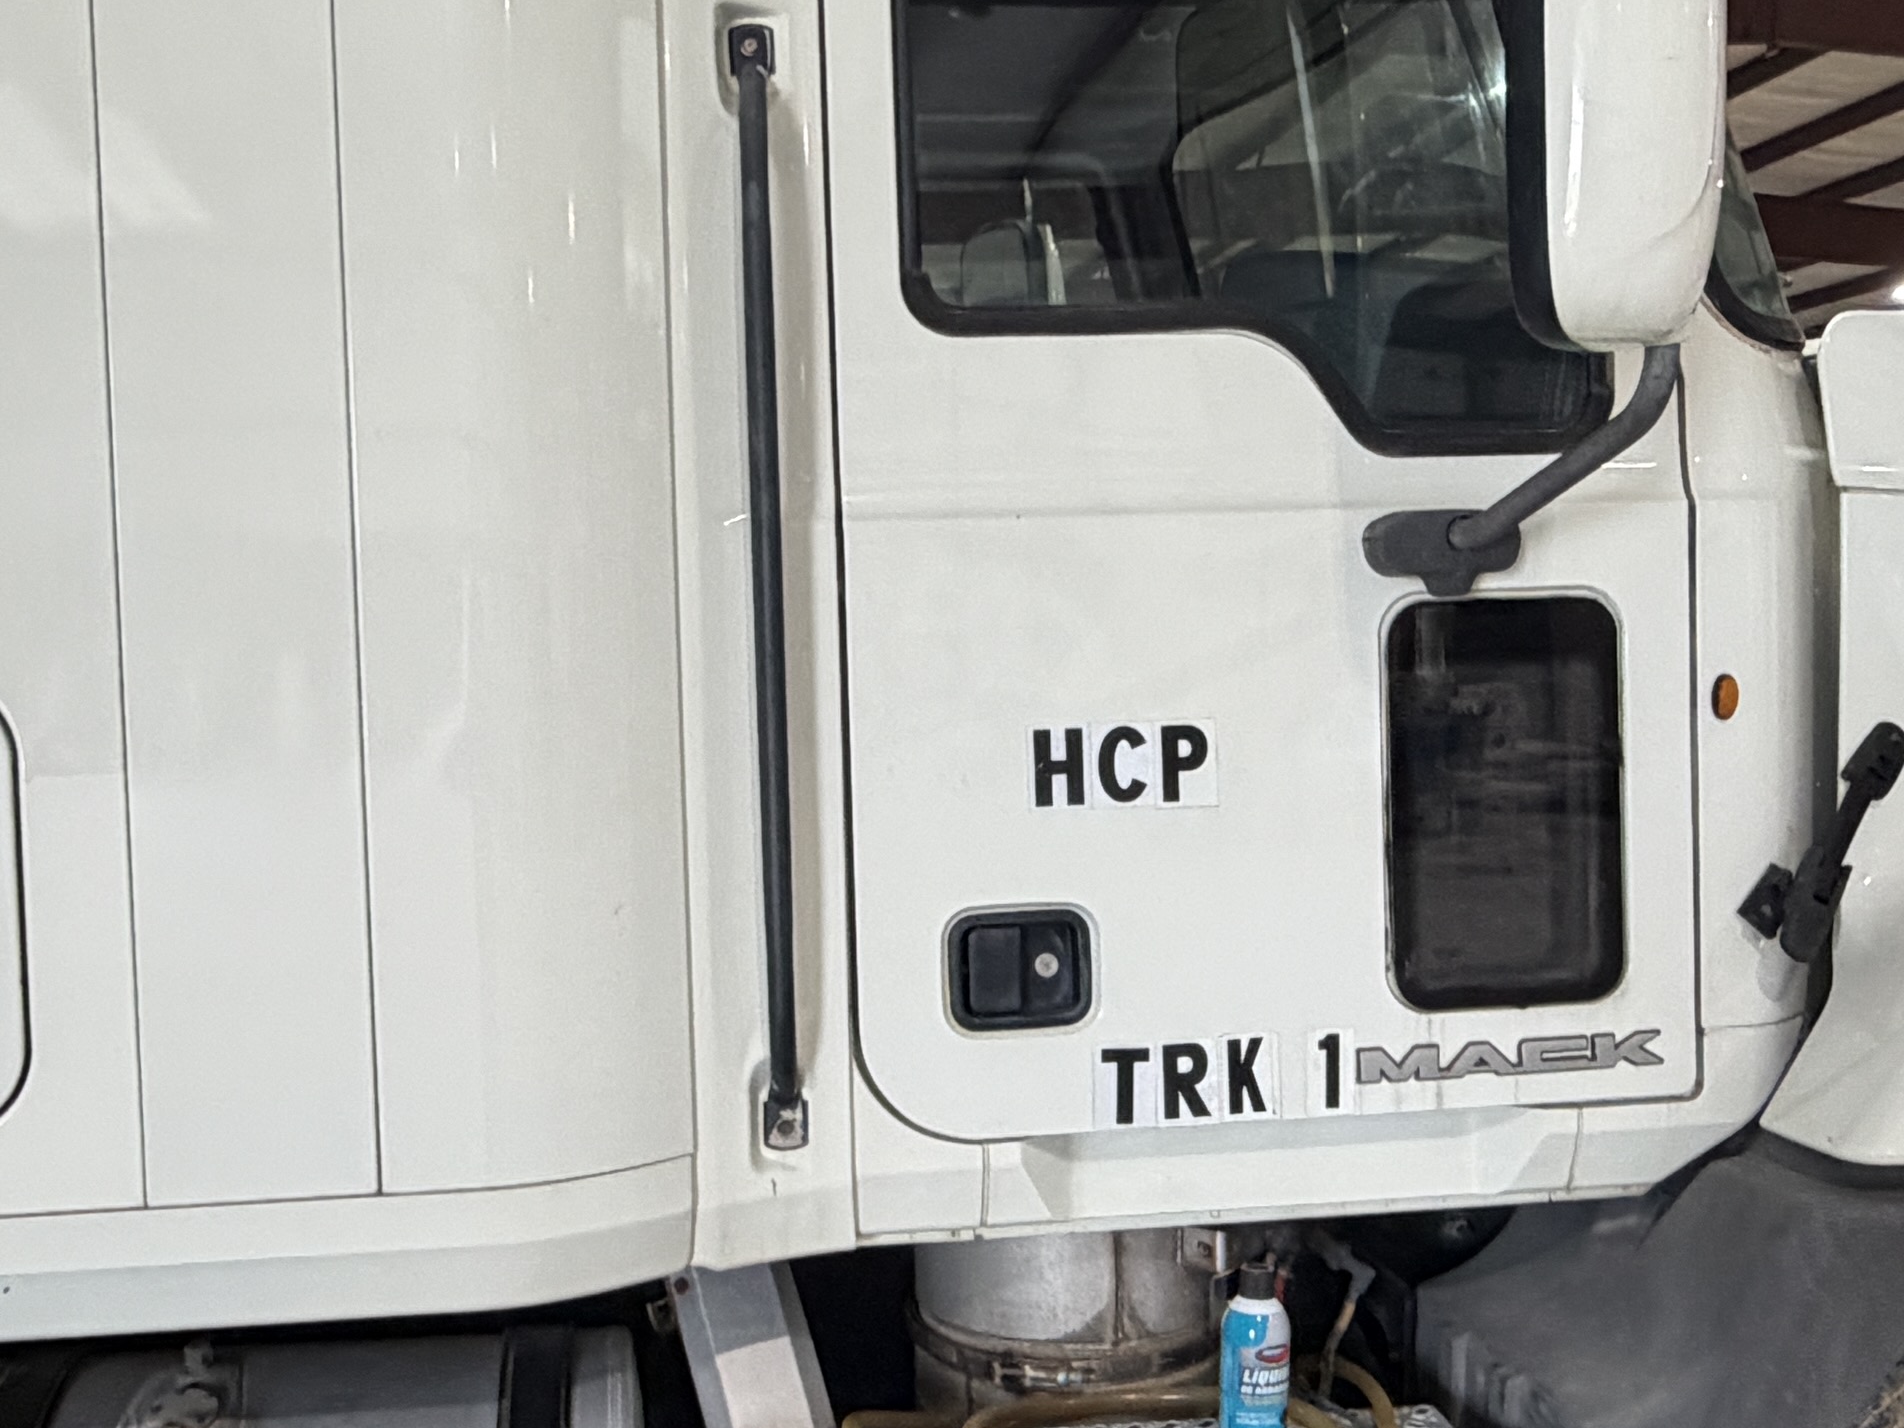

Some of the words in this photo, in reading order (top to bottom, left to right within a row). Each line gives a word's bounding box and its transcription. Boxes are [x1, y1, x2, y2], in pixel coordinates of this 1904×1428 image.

[1033, 724, 1208, 807] HCP
[1101, 1037, 1267, 1125] TRK
[1318, 1033, 1340, 1109] 1
[1356, 1029, 1664, 1084] MACK
